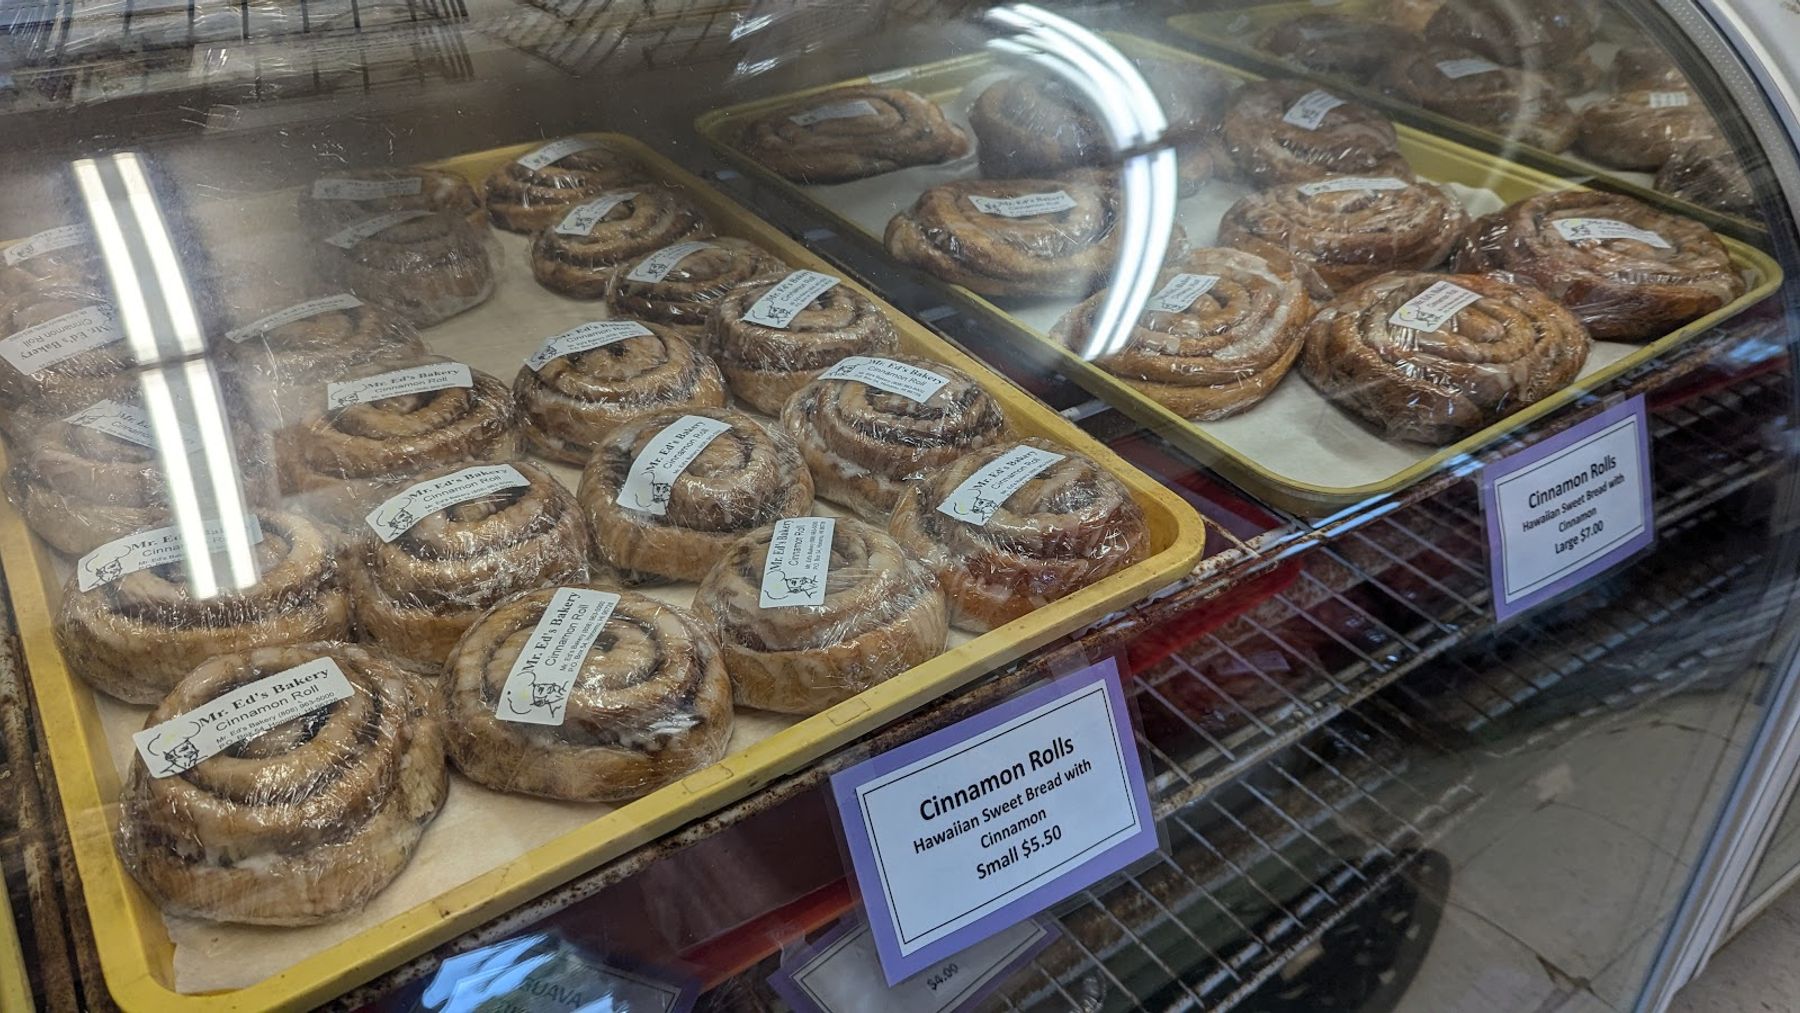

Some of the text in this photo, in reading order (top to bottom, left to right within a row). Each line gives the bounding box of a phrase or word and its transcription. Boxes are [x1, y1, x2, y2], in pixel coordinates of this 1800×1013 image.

[22, 335, 44, 348] Roll
[44, 318, 93, 338] Cinnamon
[21, 341, 62, 360] Bakery
[867, 365, 908, 381] Cinnamon
[888, 362, 908, 373] Ed's
[910, 369, 944, 386] Bakery
[645, 421, 706, 471] Mr. Ed's Bakery
[663, 438, 695, 469] Cinnamon
[693, 428, 709, 439] Roll
[410, 488, 432, 499] Mr.
[435, 478, 462, 490] Ed's
[464, 469, 507, 481] Bakery
[423, 481, 478, 502] Cinnamon
[479, 474, 501, 484] Roll
[973, 451, 1038, 489] Mr. Ed's Bakery
[991, 466, 1027, 489] Cinnamon
[1529, 454, 1617, 509] Cinnamon Rolls
[1522, 473, 1625, 533] Hawaiian Sweet Bread with
[1558, 507, 1598, 533] Cinnamon
[131, 539, 158, 551] Mr.
[769, 520, 794, 570] Mr. Ed's Bakery
[788, 537, 803, 566] Cinnamon
[1554, 520, 1604, 554] Large $7.00
[522, 592, 581, 671] Mr. Ed's Bakery
[545, 604, 590, 667] Cinnamon Roll
[200, 668, 329, 728] Mr. Ed's Bakery
[215, 684, 319, 732] Cinnamon Roll
[217, 735, 229, 745] Mr.
[230, 726, 247, 738] Ed's
[249, 715, 277, 729] Bakery
[278, 706, 299, 719] (808)
[919, 737, 1075, 822] Cinnamon Rolls
[913, 758, 1092, 854] Hawaiian Sweet Bread with
[980, 809, 1047, 849] Cinnamon
[976, 824, 1062, 880] Small $5.50
[927, 963, 959, 991] $4.00
